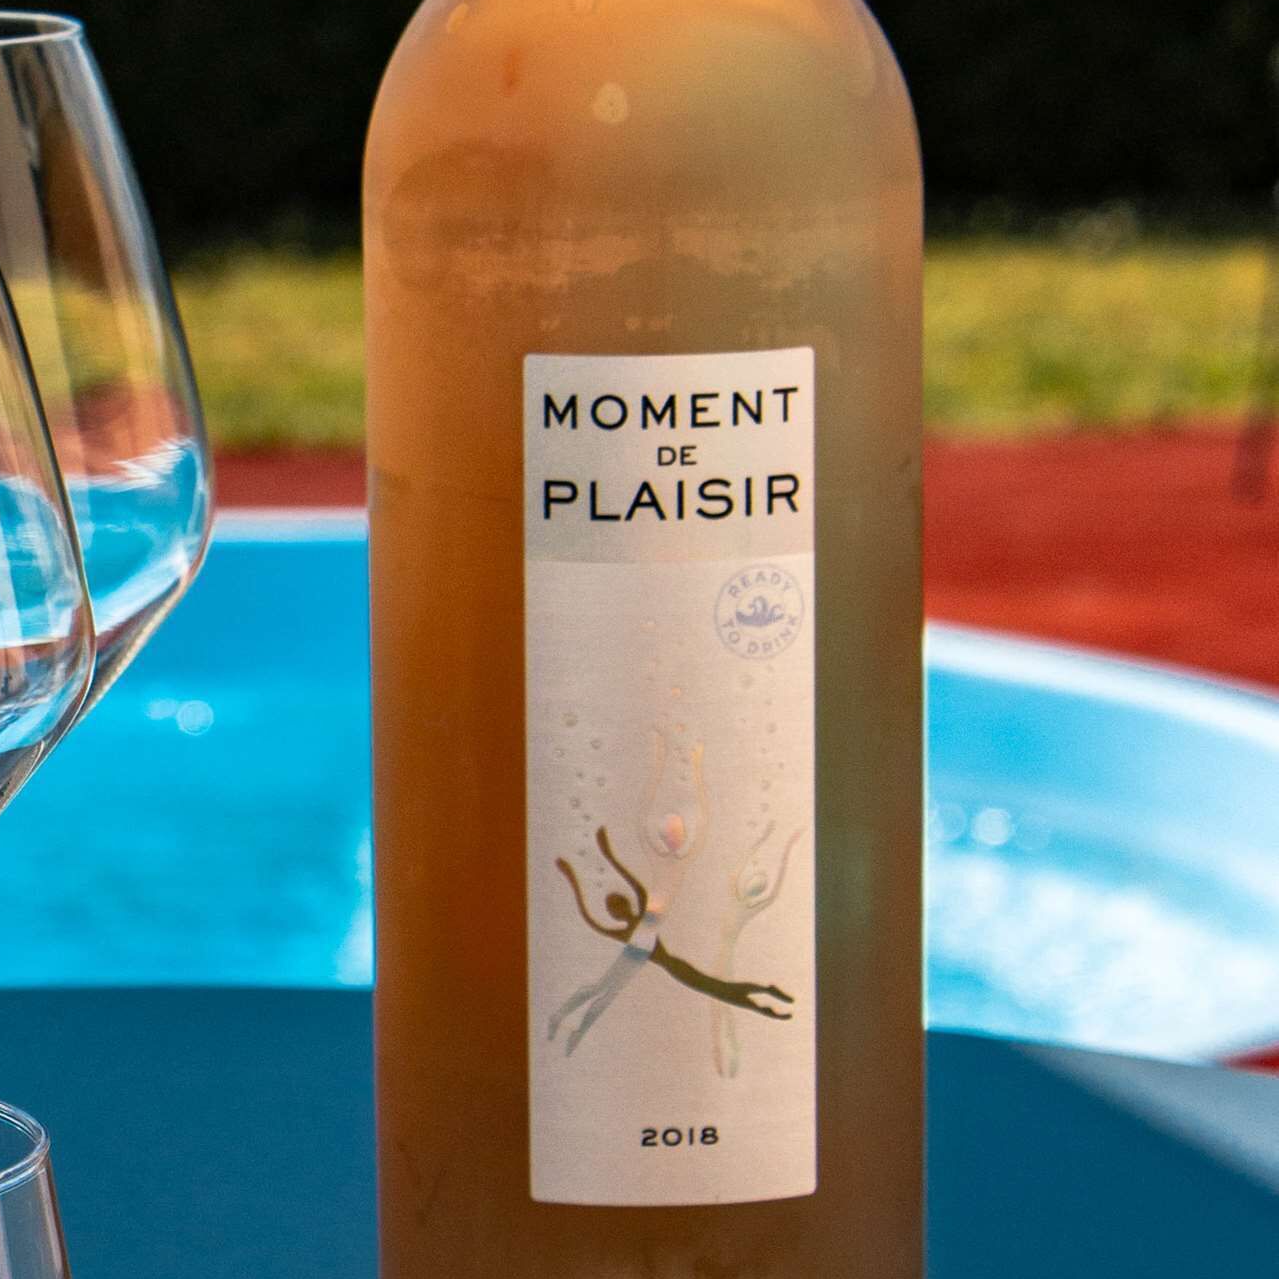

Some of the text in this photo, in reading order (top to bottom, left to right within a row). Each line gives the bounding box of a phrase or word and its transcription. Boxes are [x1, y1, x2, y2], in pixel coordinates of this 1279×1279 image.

[543, 386, 799, 430] MOMENT
[657, 445, 698, 467] DE
[543, 473, 800, 521] PLAISIR
[728, 571, 793, 598] READY
[640, 1126, 719, 1147] 2018
